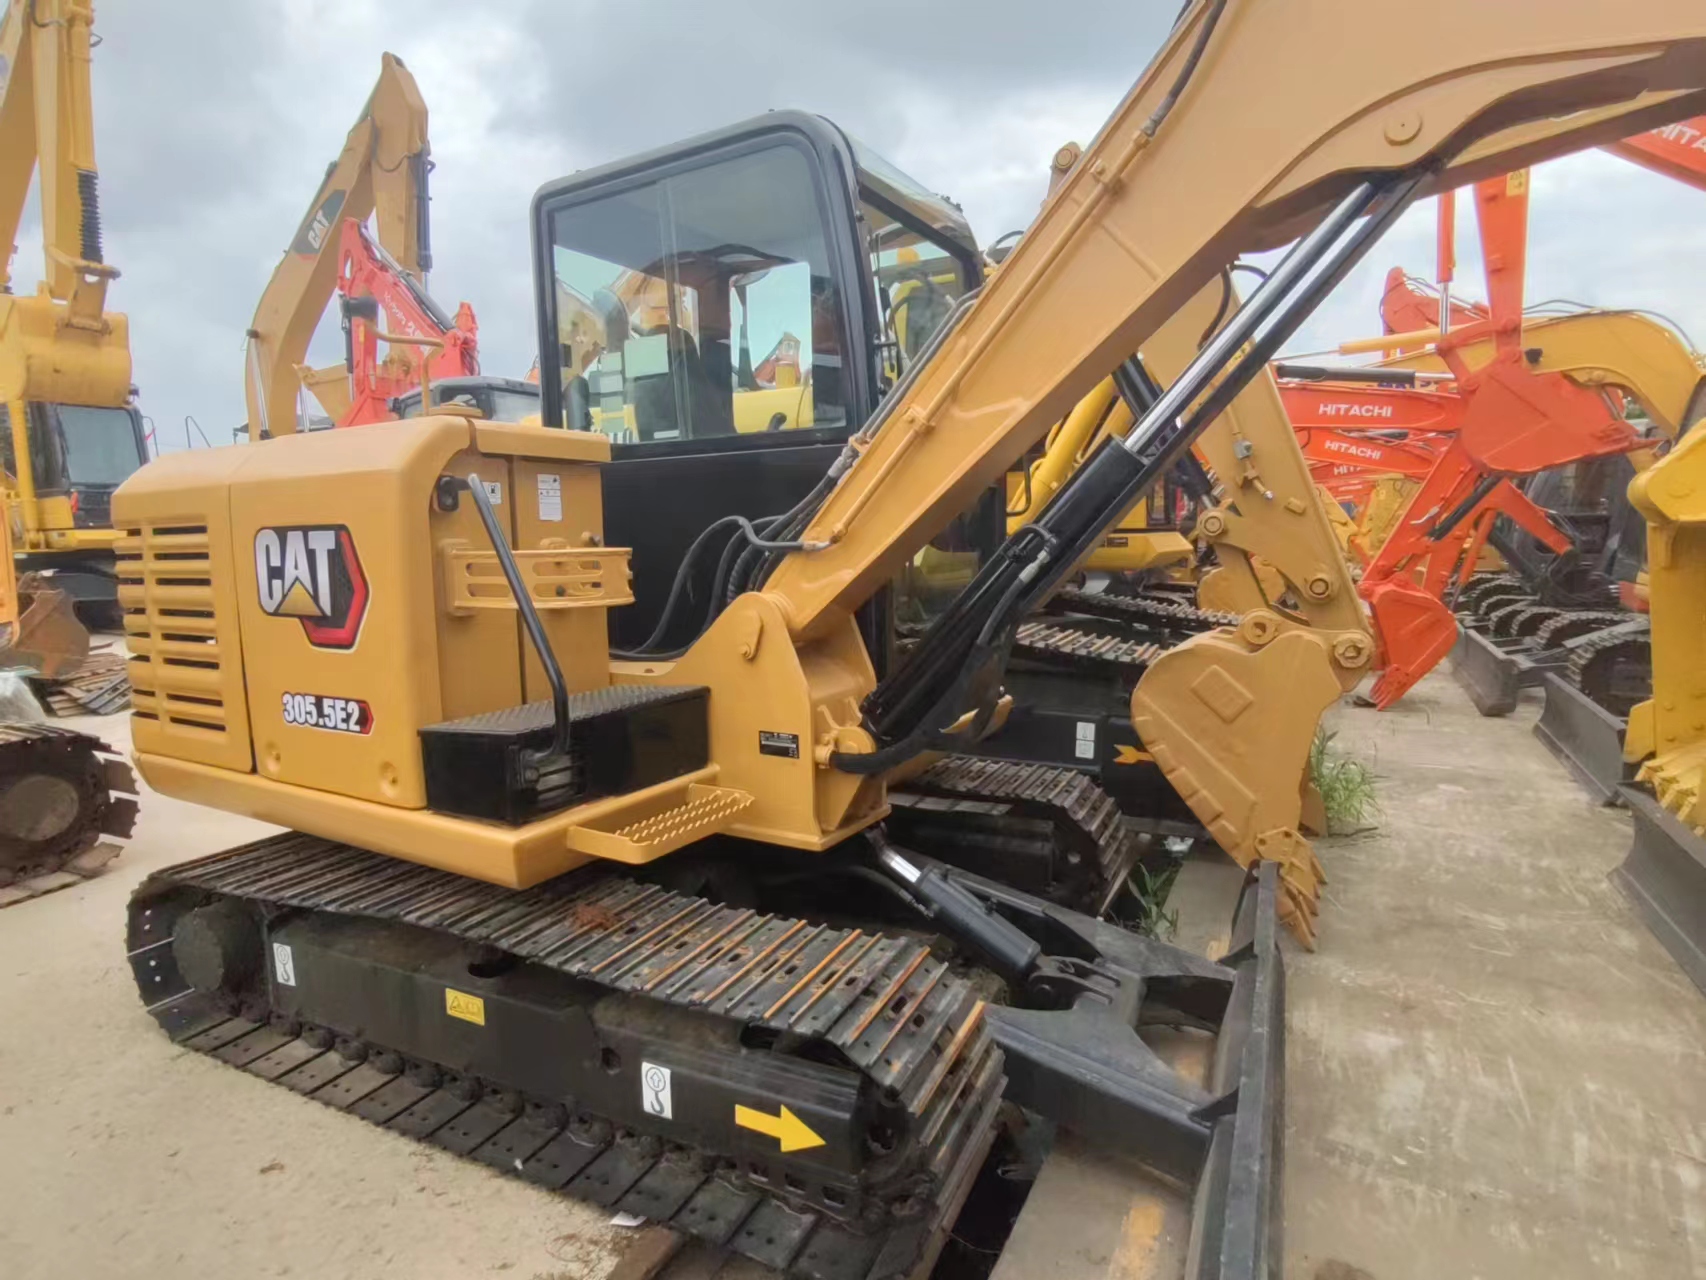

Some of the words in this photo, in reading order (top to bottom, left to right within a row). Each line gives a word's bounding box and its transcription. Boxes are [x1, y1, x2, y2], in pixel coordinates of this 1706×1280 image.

[308, 209, 329, 249] CAT
[1319, 403, 1393, 417] HITACHI
[1324, 440, 1382, 460] HITACHI
[255, 529, 336, 617] CAT
[282, 692, 361, 732] 305.5E2
